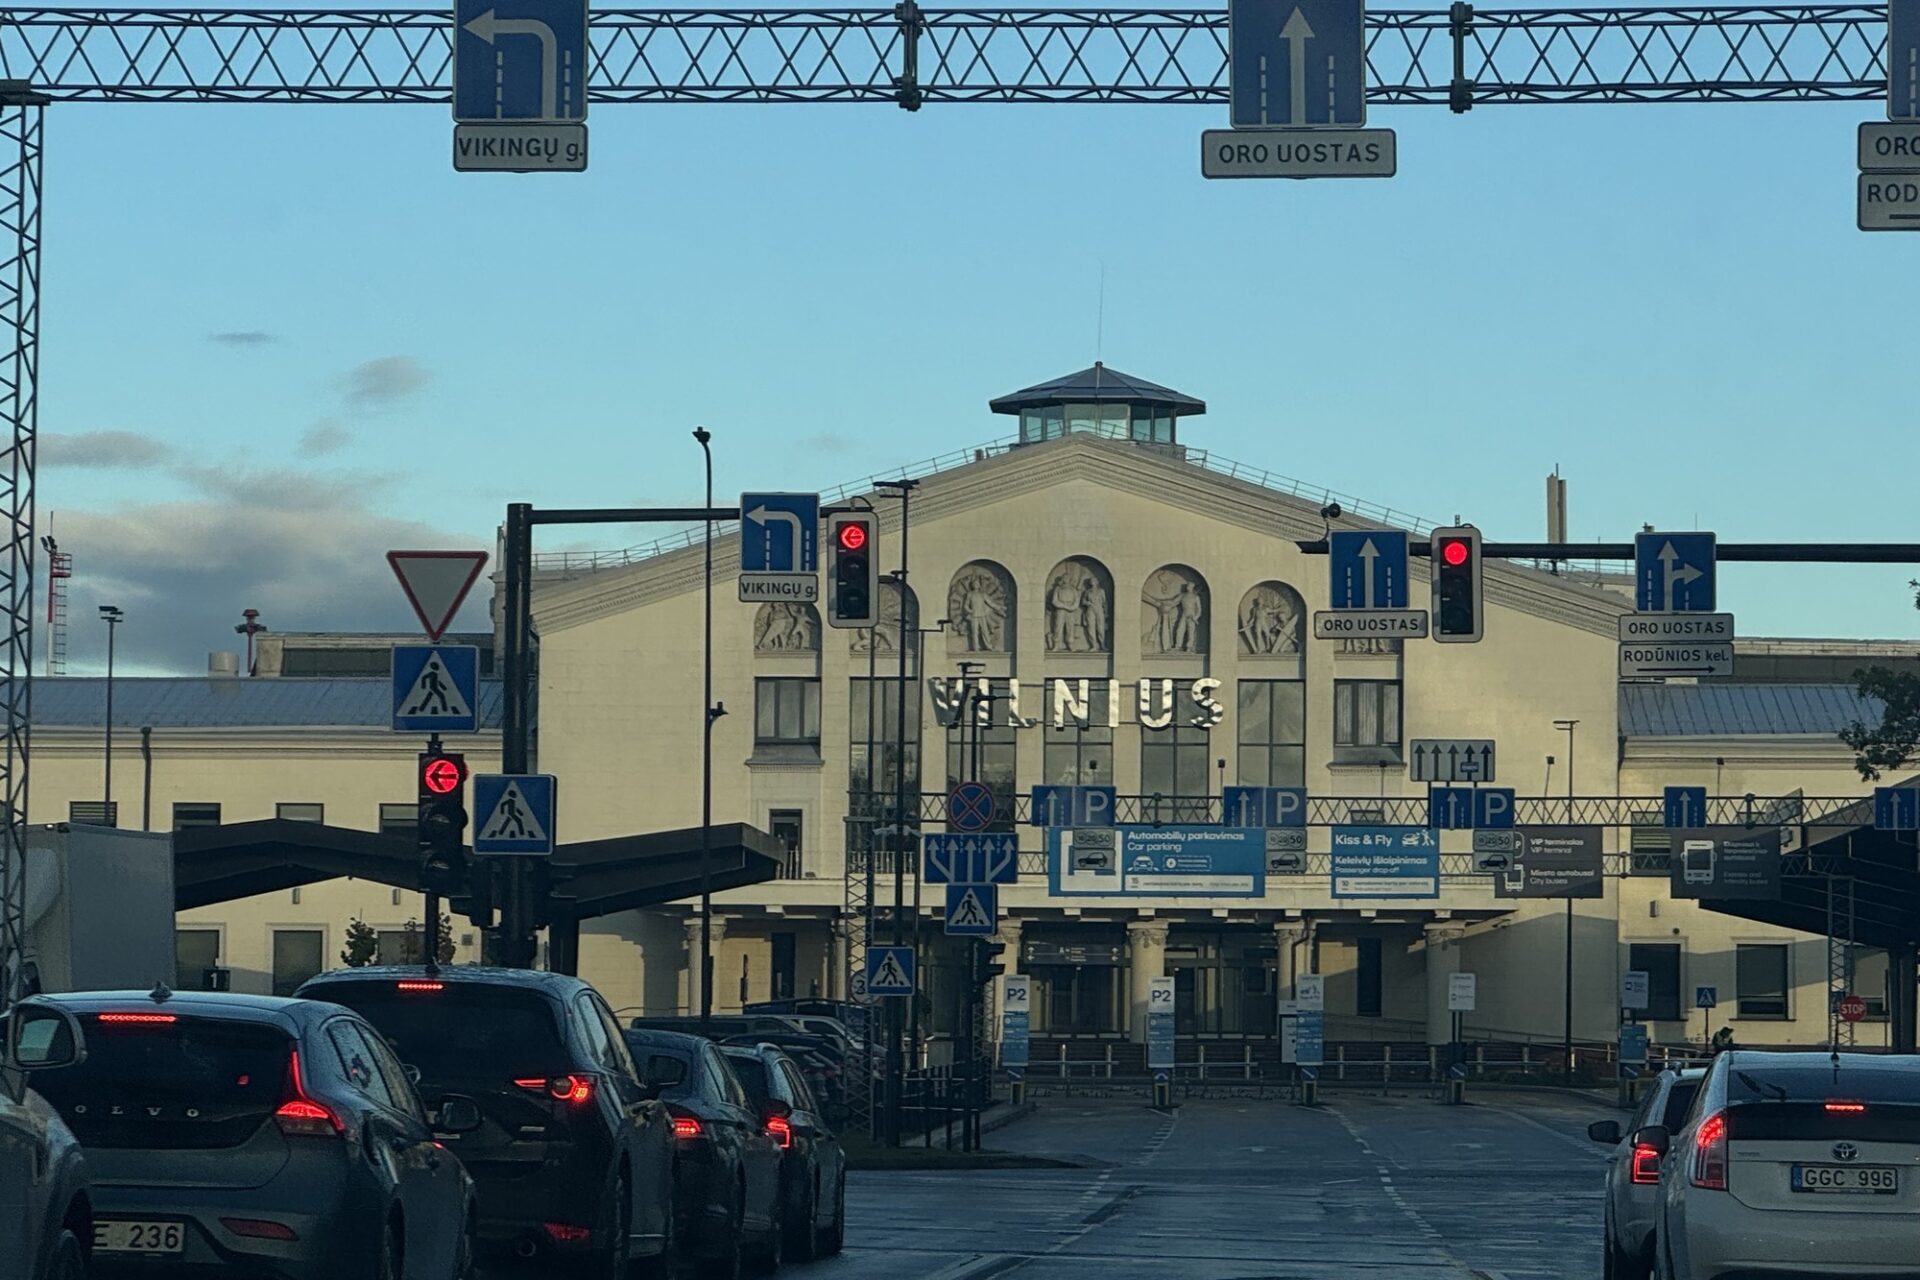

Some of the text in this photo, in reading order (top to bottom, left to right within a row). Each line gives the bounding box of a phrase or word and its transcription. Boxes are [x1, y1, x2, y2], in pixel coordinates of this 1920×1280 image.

[458, 137, 584, 163] VIKINGŲ g.
[1219, 143, 1380, 163] ORO UOSTAS
[741, 582, 817, 598] VIKINGŲ g.
[1324, 618, 1418, 631] ORO UOSTAS
[1628, 621, 1725, 634] ORO UOSTAS
[1624, 647, 1701, 662] RODŪNIOS
[927, 676, 1224, 729] VILNIUS
[1085, 790, 1108, 823] P
[1276, 791, 1299, 824] P
[1484, 792, 1507, 825] P
[1188, 831, 1245, 842] parkavimas
[1335, 834, 1393, 848] Kiss & Fly
[1530, 838, 1543, 846] VIP
[1127, 842, 1182, 853] Car parking
[210, 972, 218, 989] 1
[1007, 988, 1027, 1001] P2
[1151, 989, 1171, 1003] P2
[1840, 1003, 1865, 1015] STOP
[74, 1104, 200, 1118] OLVO
[1805, 1168, 1894, 1188] GGC 996
[128, 1224, 180, 1249] 236
